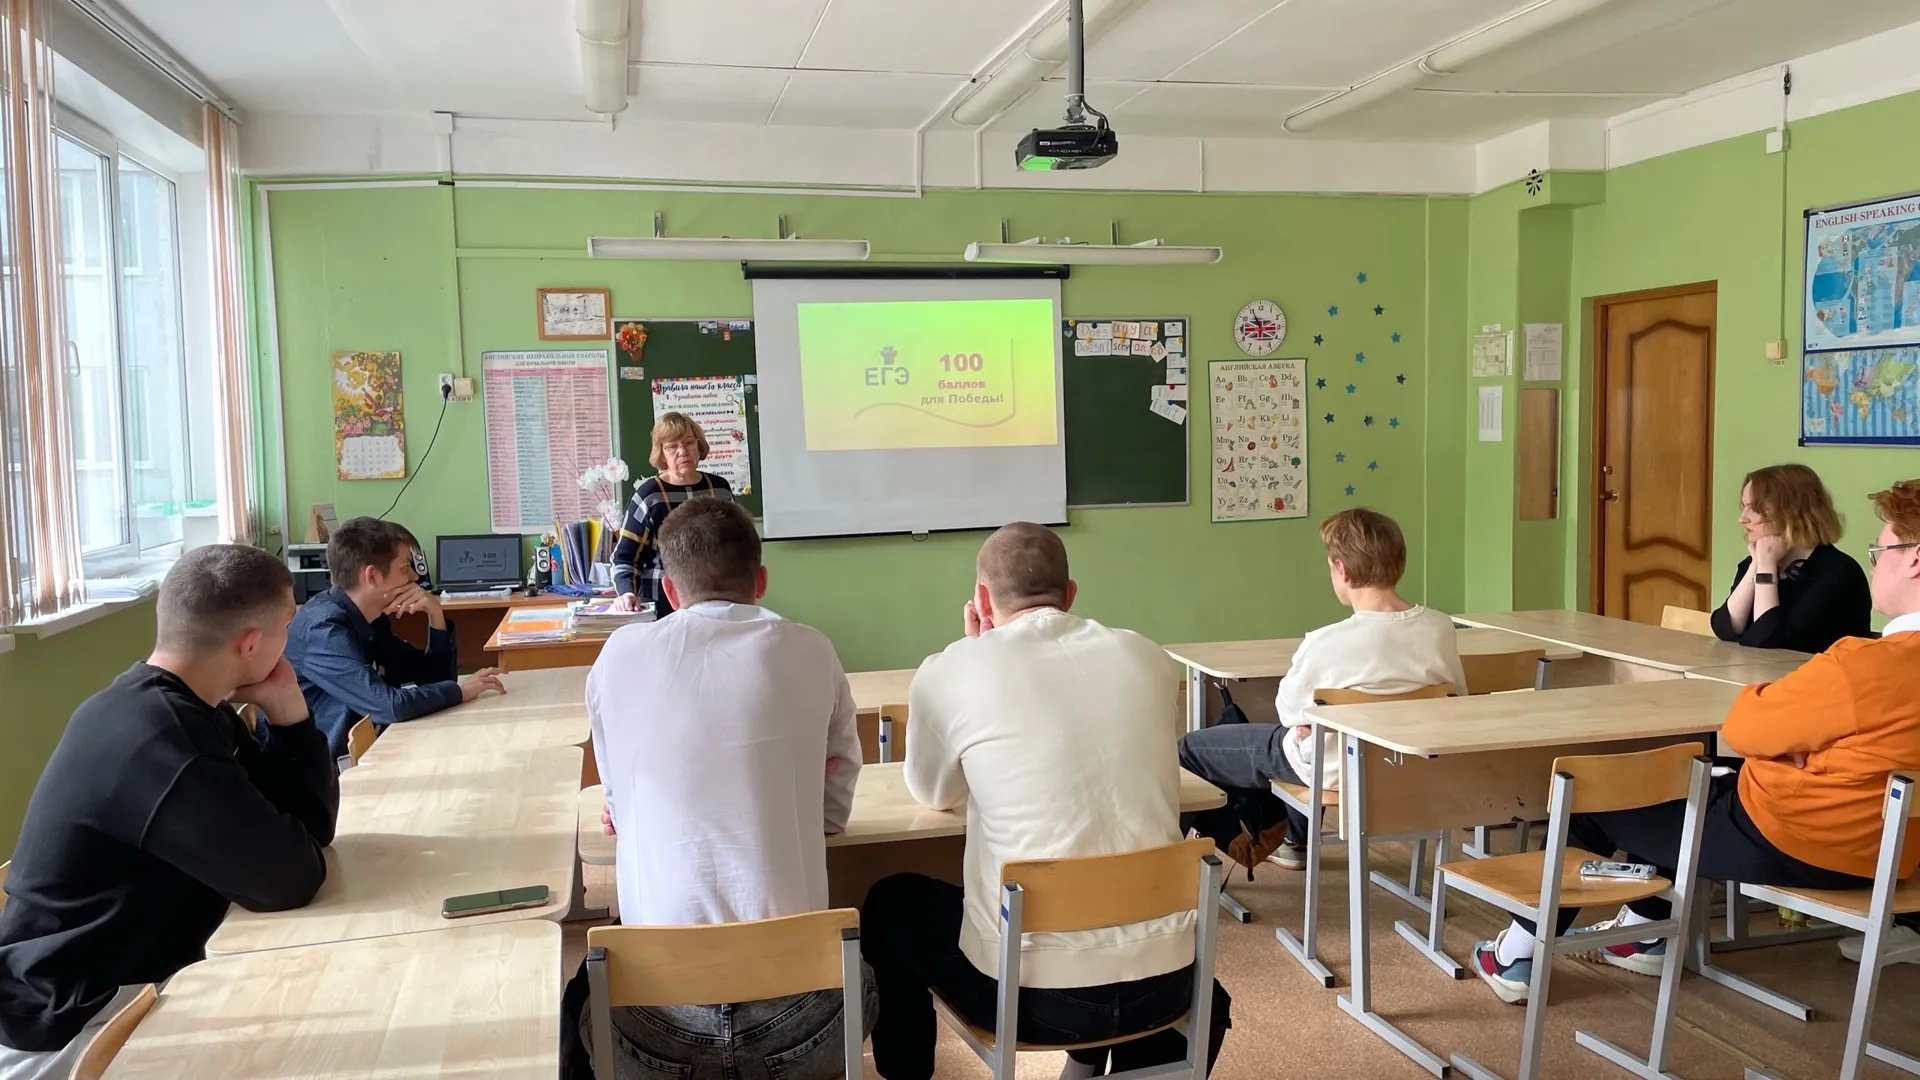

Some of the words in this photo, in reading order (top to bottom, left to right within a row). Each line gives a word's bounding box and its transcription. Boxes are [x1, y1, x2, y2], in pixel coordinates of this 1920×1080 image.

[1815, 203, 1915, 229] ENGLISH-SPEAKING
[1113, 323, 1137, 335] any
[1143, 325, 1152, 336] a
[939, 353, 984, 372] 100
[1220, 363, 1267, 371] АНГЛИЙСКАЯ
[865, 367, 910, 386] ЕГЭ
[1281, 373, 1292, 381] Dd
[938, 380, 986, 389] баллов
[921, 395, 944, 406] для
[949, 393, 1004, 405] Победы!
[1217, 457, 1226, 465] Qq
